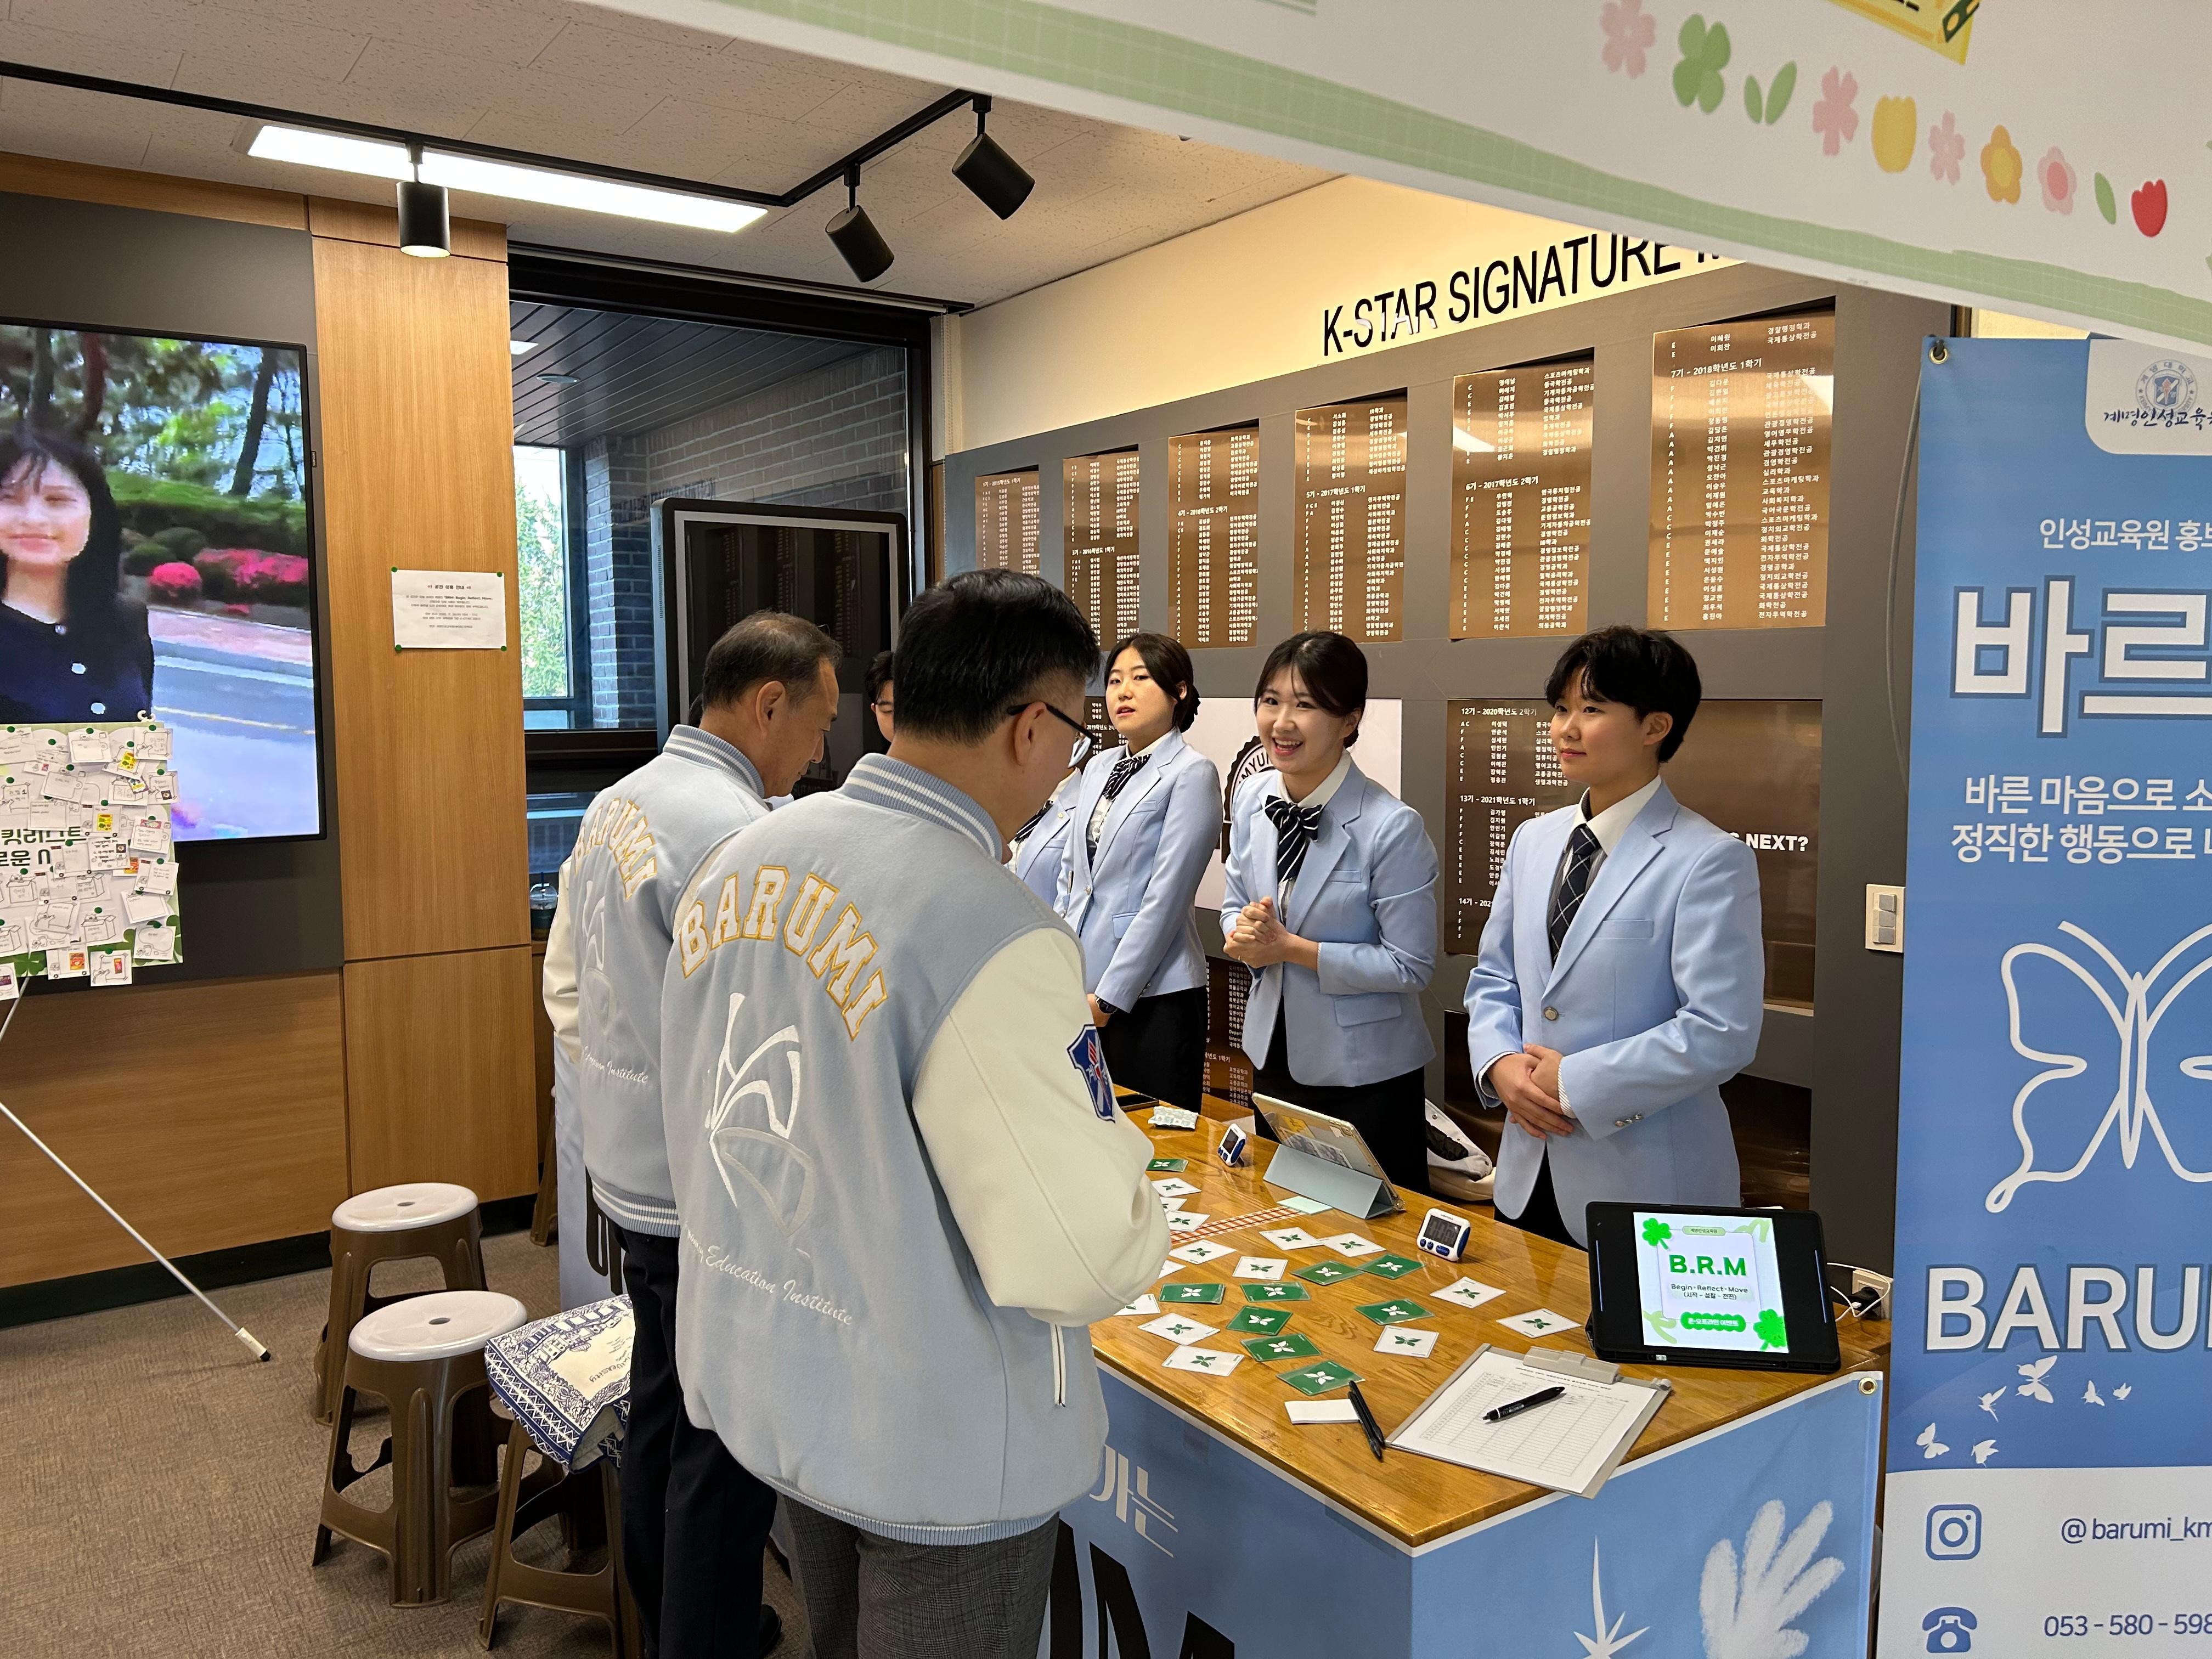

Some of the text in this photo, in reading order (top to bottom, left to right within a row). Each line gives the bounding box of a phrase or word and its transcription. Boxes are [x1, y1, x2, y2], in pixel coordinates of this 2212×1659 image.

[1323, 233, 1680, 356] K-STAR SIGNATURE
[1767, 321, 1810, 335] 경찰행정학과
[1767, 330, 1817, 345] 국제통상학전공
[1671, 358, 1762, 378] 7기 2018학년도 1학기
[2103, 408, 2212, 431] 계명인성교육
[1763, 456, 1798, 467] 경영학전공
[1465, 476, 1538, 490] 6기 2017학년도 2학기
[1762, 474, 1820, 486] 스포츠마케팅학과
[1760, 513, 1818, 523] 스포츠마케팅학과
[2039, 518, 2170, 551] 인성교육원
[1760, 543, 1810, 552] 국제통상학전공
[1759, 581, 1809, 590] 국제통상학전공
[1758, 591, 1808, 600] 국제통상학전공
[1952, 577, 2212, 735] 바르
[1482, 708, 1517, 716] 2020학년도
[1520, 708, 1536, 716] 2학기
[1481, 797, 1516, 805] 2021학년도
[1518, 798, 1535, 806] 1학기
[1965, 774, 2033, 815] 바른
[2040, 775, 2177, 816] 마음으로
[1746, 833, 1809, 851] NEXT?
[1951, 823, 2053, 863] 정직한
[2059, 823, 2196, 865] 행동으로
[1459, 898, 1472, 906] 14기
[679, 865, 889, 1041] BARUMI
[1669, 1254, 1746, 1276] B.R.M
[706, 1245, 776, 1295] Education
[783, 1279, 853, 1327] Institute
[1925, 1265, 2212, 1352] BARU
[2044, 1615, 2088, 1637] 053
[2109, 1614, 2153, 1636] 580
